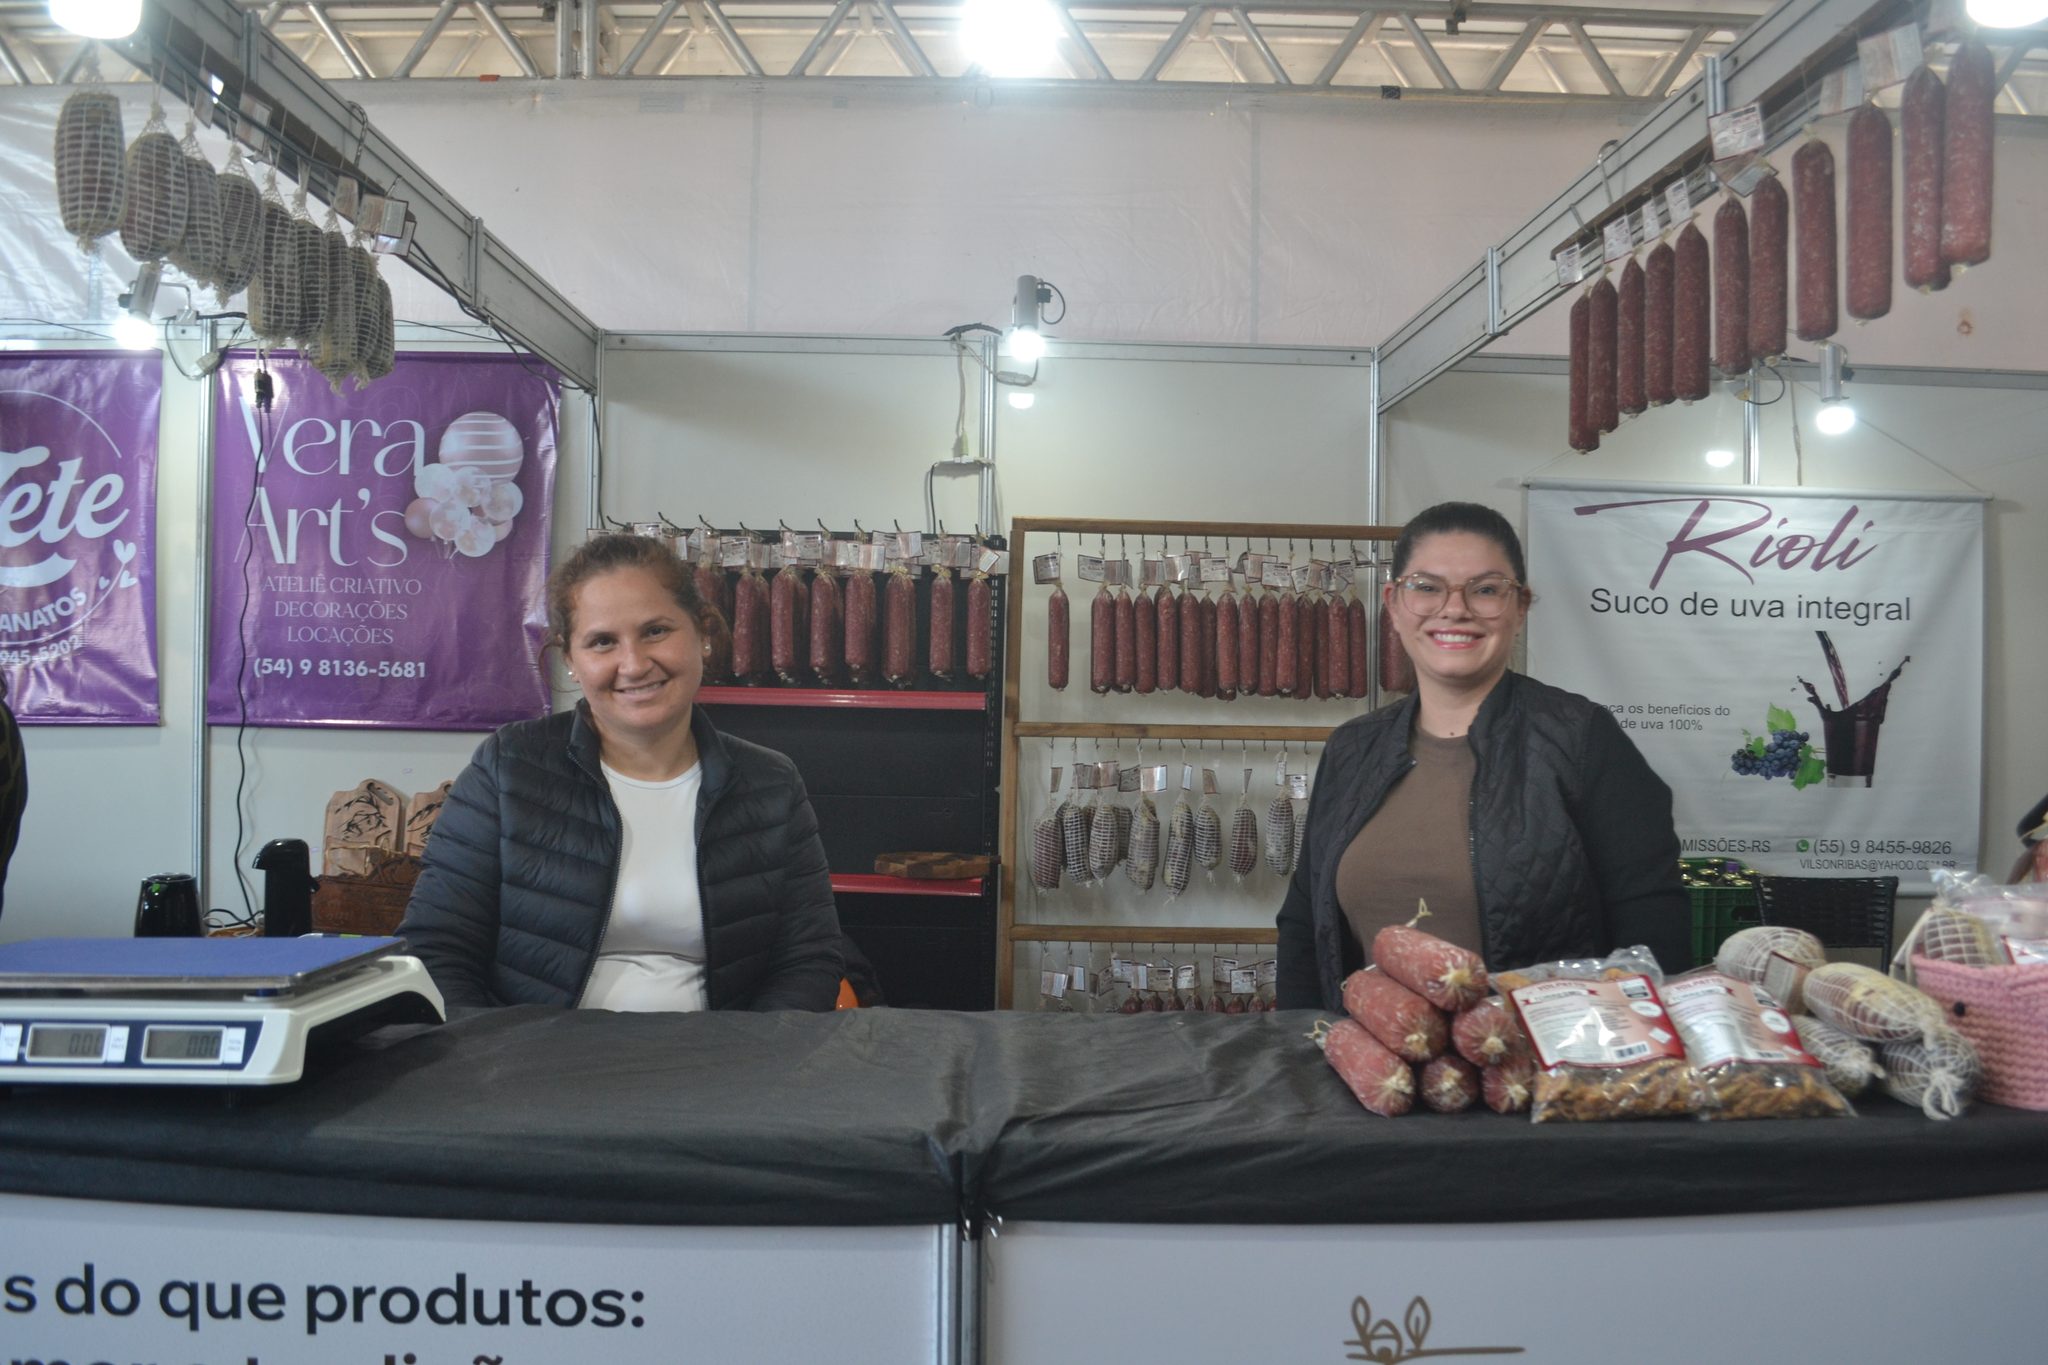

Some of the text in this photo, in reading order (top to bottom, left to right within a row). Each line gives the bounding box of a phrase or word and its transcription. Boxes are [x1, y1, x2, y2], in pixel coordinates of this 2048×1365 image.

[238, 397, 426, 478] Vera
[1574, 497, 1879, 591] Rioli
[262, 573, 423, 596] ATELIÊ CRIATIVO
[275, 600, 409, 622] DECORAÇÕES
[1590, 587, 1911, 627] Suco de uva integral
[287, 624, 395, 647] LOCAÇÕES
[253, 657, 427, 679] (54) 9 8136-5681
[1627, 704, 1645, 715] os
[1714, 705, 1731, 717] do
[1620, 718, 1704, 731] de uva 100%
[1681, 837, 1772, 854] MISSÕES-RS
[1813, 839, 1952, 857] (55) 9 8455-9826
[55, 1263, 141, 1317] do
[159, 1279, 287, 1332] que
[306, 1272, 645, 1335] produtos:
